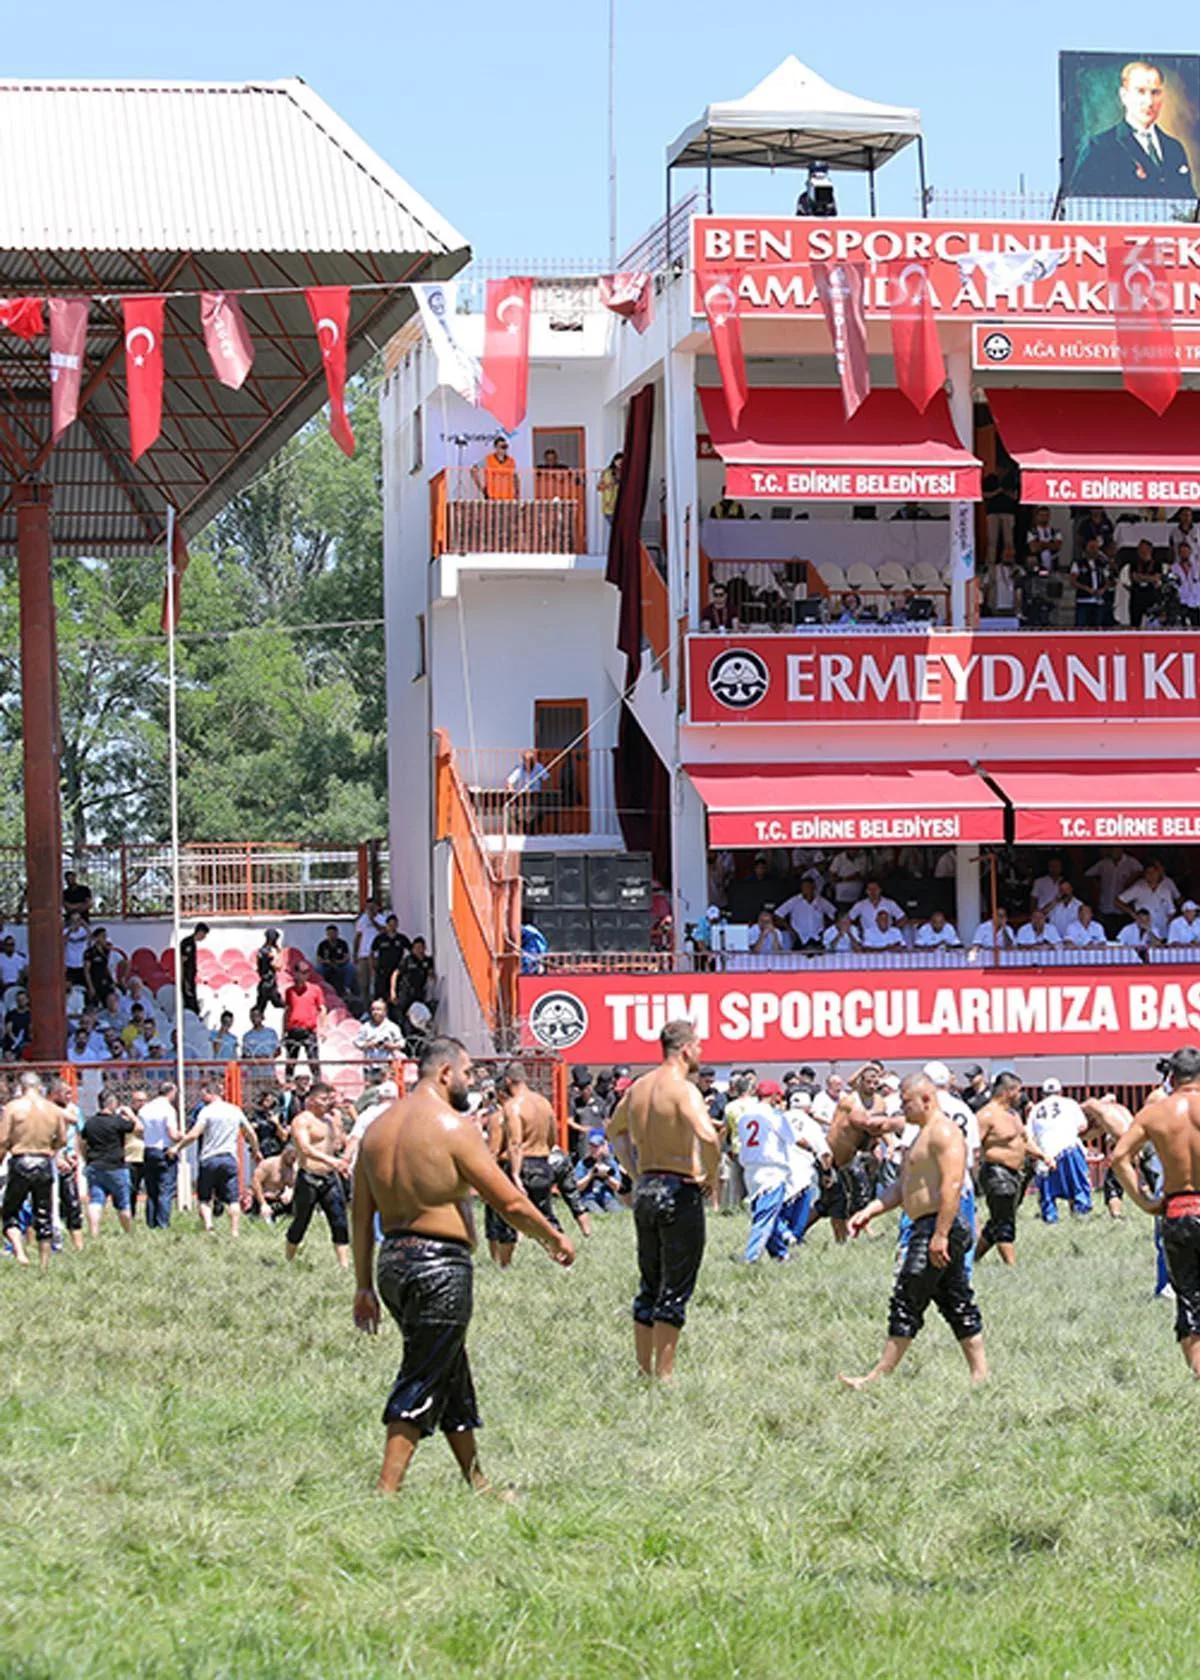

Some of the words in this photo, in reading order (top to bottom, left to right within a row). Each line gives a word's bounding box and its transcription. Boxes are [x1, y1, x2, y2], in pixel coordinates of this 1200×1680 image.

[704, 229, 793, 261] BEN
[1022, 340, 1057, 358] AĞA
[752, 474, 783, 493] T.C.
[788, 470, 851, 494] EDİRNE
[856, 471, 956, 495] BELEDİYESİ
[1046, 479, 1077, 499] T.C.
[1081, 477, 1143, 500] EDİRNE
[755, 821, 787, 840] T.C.
[791, 816, 855, 840] EDİRNE
[859, 815, 960, 839] BELEDİYESİ
[1060, 818, 1090, 837] T.C.
[1095, 813, 1158, 837] EDİRNE
[604, 993, 710, 1042] TÜM
[720, 985, 1120, 1040] SPORCULARIMIZA
[746, 1120, 760, 1147] 2
